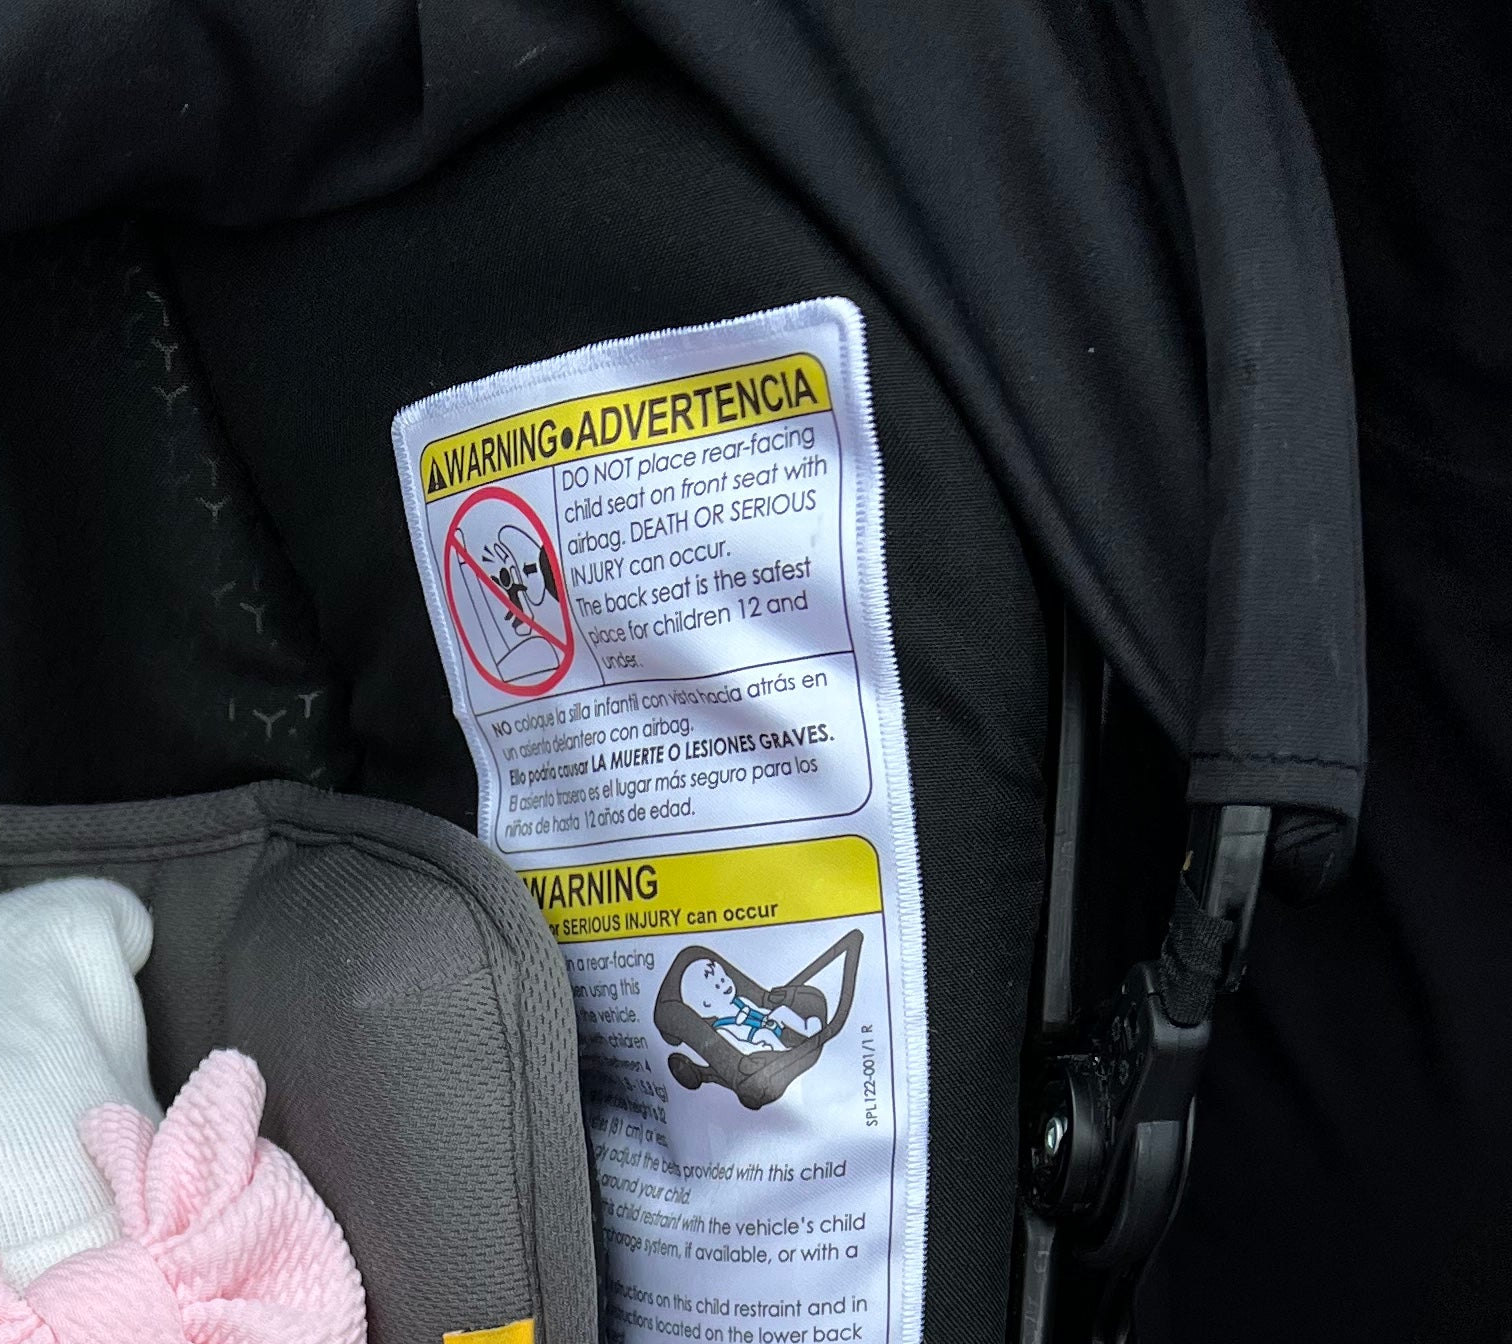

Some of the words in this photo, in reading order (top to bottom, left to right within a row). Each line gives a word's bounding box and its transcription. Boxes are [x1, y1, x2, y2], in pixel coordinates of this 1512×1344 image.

[444, 420, 557, 485] WARNING
[575, 368, 818, 451] ADVERTENCIA
[562, 466, 589, 491] DO
[594, 457, 634, 484] NOT
[638, 452, 696, 480] place
[702, 426, 815, 464] rear-facing
[565, 496, 602, 523] child
[608, 486, 645, 514] seat
[650, 486, 674, 505] on
[682, 472, 728, 499] front
[733, 463, 778, 490] seat
[784, 454, 827, 480] with
[568, 530, 626, 556] airbag.
[630, 510, 688, 542] DEATH
[694, 504, 724, 528] OR
[730, 489, 816, 522] SERIOUS
[571, 557, 624, 588] INJURY
[630, 554, 664, 576] can
[670, 540, 730, 567] occur.
[576, 598, 602, 617] The
[606, 586, 647, 613] back
[652, 576, 690, 604] seat
[696, 574, 708, 596] is
[713, 570, 746, 592] the
[752, 556, 812, 585] safest
[588, 626, 626, 648] place
[628, 620, 648, 640] for
[653, 608, 730, 636] children
[738, 596, 761, 619] 12
[767, 590, 808, 614] and
[747, 674, 795, 698] atrás
[802, 673, 827, 688] en
[610, 726, 638, 742] con
[642, 717, 694, 738] airbag.
[592, 753, 607, 773] LA
[610, 745, 664, 770] MUERTE
[668, 743, 680, 762] O
[686, 734, 756, 760] LESIONES
[759, 724, 835, 750] GRAVES.
[655, 770, 686, 792] más
[690, 768, 746, 789] seguro
[563, 914, 621, 936] SERIOUS
[625, 908, 681, 930] INJURY
[687, 910, 717, 925] can
[723, 904, 778, 922] occur
[861, 1024, 873, 1033] R
[861, 1039, 878, 1127] SPL122-001/1
[768, 1164, 794, 1182] this
[800, 1160, 846, 1181] child
[736, 1217, 814, 1236] vehicle's
[820, 1212, 866, 1233] child
[696, 1245, 772, 1264] available,
[801, 1243, 838, 1261] with
[734, 1300, 802, 1317] restraint
[808, 1296, 845, 1316] and
[852, 1296, 867, 1312] in
[759, 1327, 808, 1344] lower
[814, 1323, 862, 1342] back
